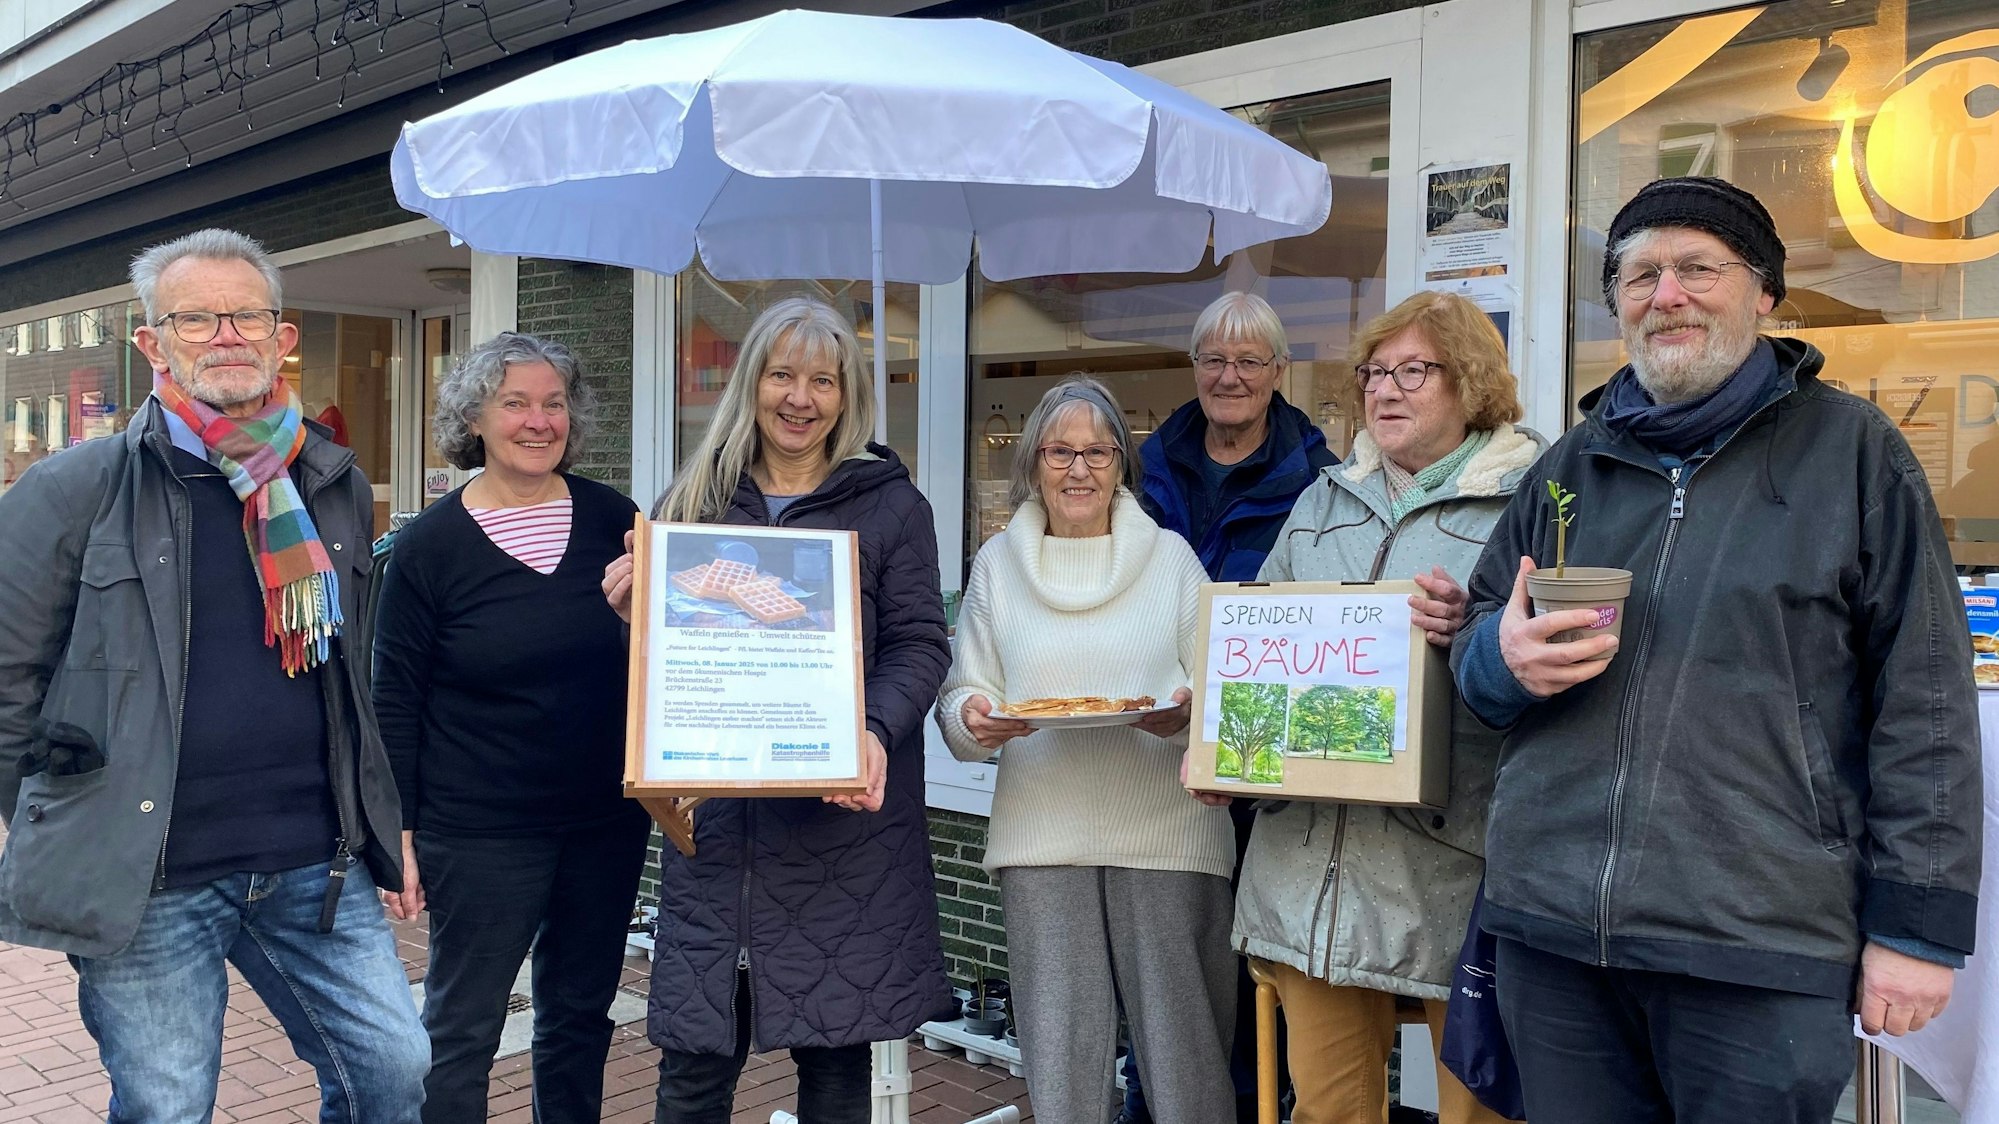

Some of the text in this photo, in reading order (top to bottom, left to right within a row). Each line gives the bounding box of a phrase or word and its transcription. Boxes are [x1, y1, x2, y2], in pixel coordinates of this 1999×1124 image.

[1431, 176, 1506, 192] Trauer auf dem Weg
[427, 470, 449, 489] Enjoy
[1221, 604, 1383, 625] SPENDEN FÜR
[1967, 609, 1999, 617] densmil
[680, 629, 710, 637] Waffeln
[712, 630, 749, 639] genießen
[760, 631, 790, 640] Umwelt
[792, 632, 826, 640] schützen
[665, 659, 701, 667] Mittwoch,
[1217, 637, 1380, 678] BÄUME
[694, 668, 742, 676] ökumenischen
[686, 685, 725, 693] Leichlingen
